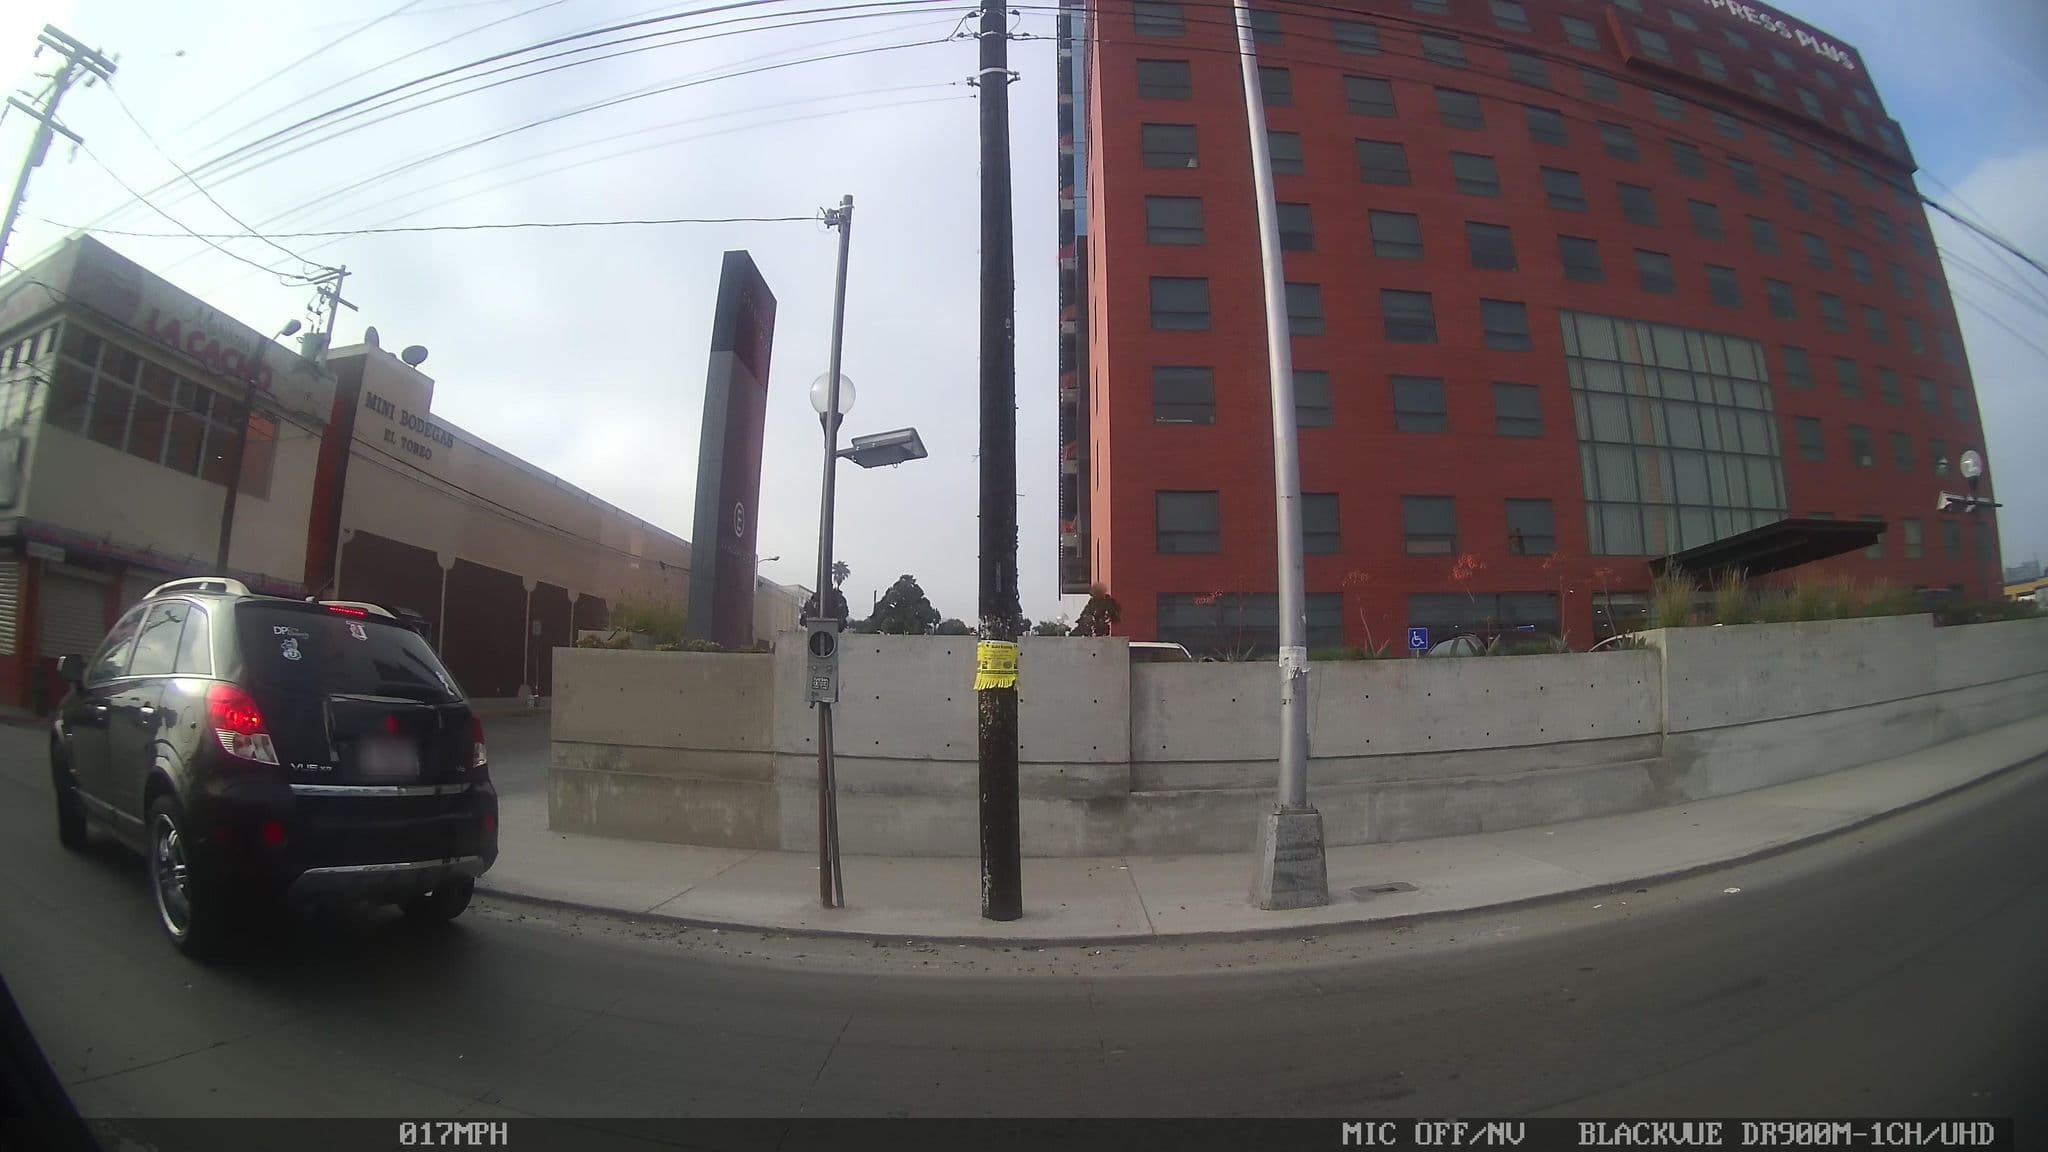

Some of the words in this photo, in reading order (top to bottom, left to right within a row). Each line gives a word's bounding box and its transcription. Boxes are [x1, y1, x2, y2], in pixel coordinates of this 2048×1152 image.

[1703, 0, 1792, 39] PRESS
[1794, 29, 1855, 71] PLUS
[366, 391, 396, 421] MINI
[400, 409, 455, 449] BODEGAS
[400, 436, 433, 461] TOREO
[290, 762, 319, 771] VUE
